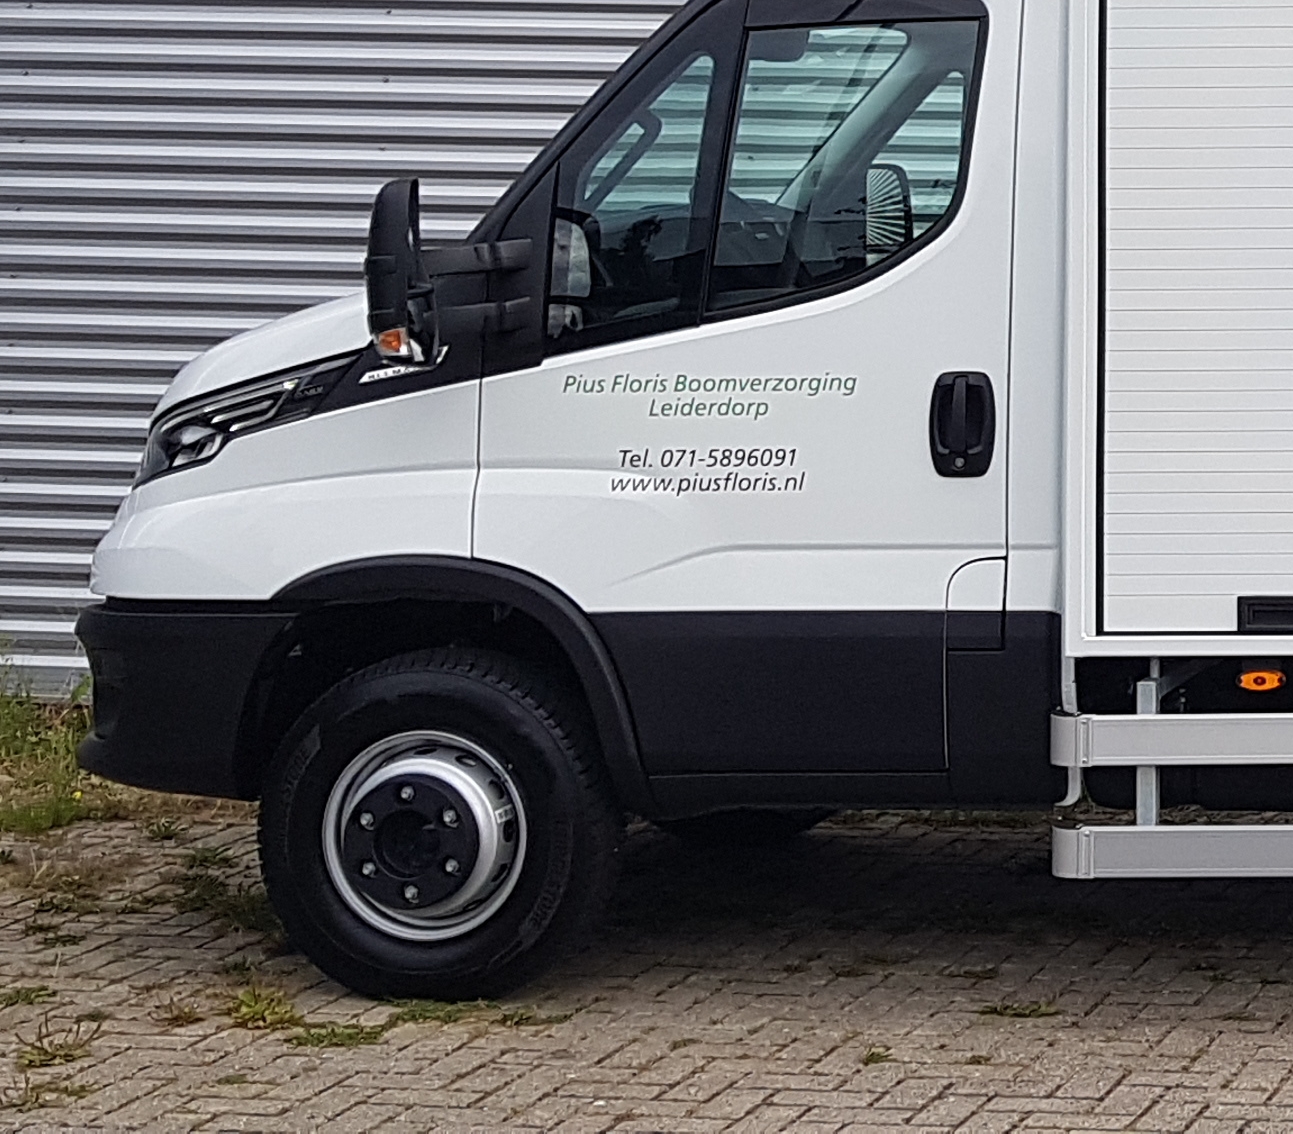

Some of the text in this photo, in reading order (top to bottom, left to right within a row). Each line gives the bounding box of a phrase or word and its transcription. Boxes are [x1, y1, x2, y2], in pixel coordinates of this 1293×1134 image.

[562, 372, 857, 397] Pius Floris Boomverzorging
[648, 398, 769, 421] Leiderdorp
[618, 448, 797, 468] Tel. 071-5896091
[611, 471, 806, 496] www.piusfloris.nl
